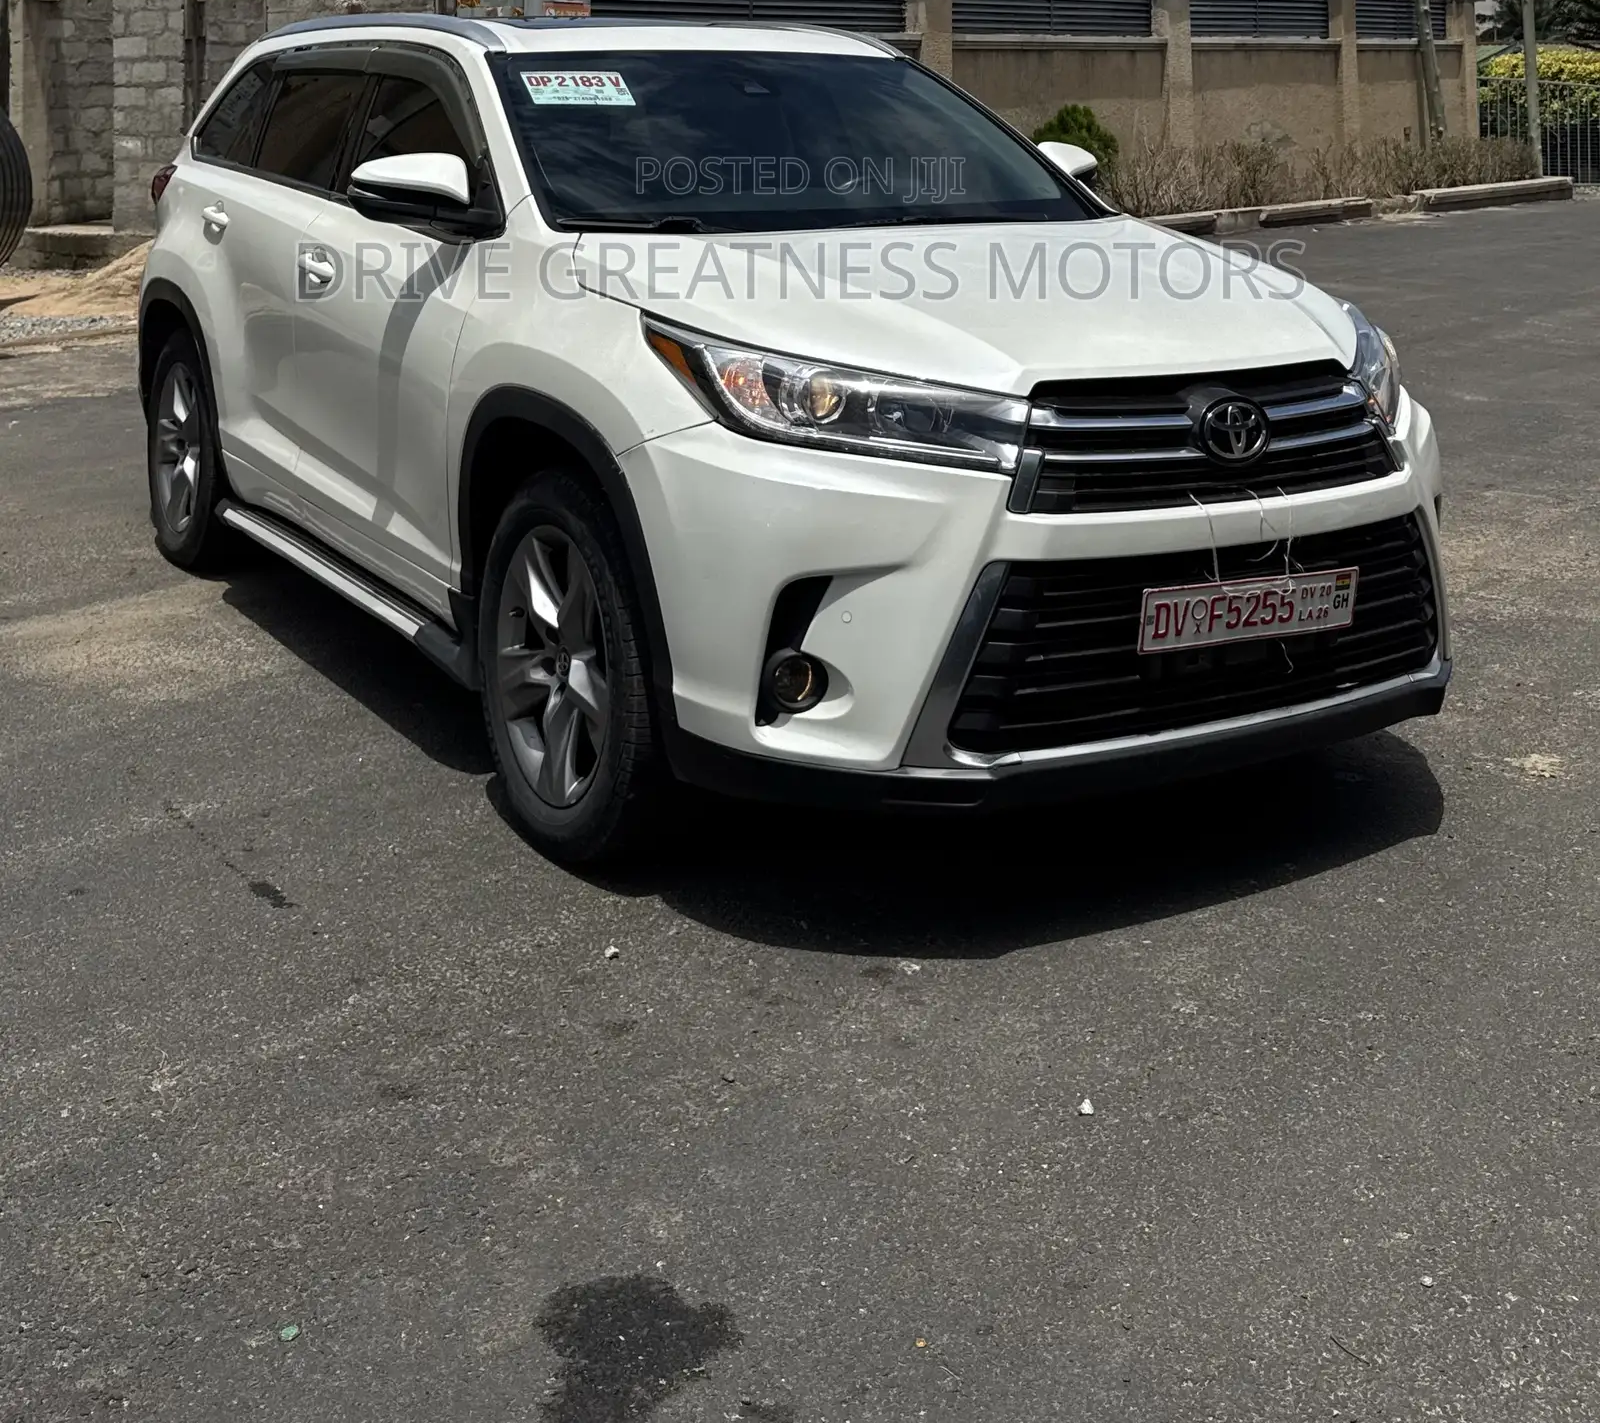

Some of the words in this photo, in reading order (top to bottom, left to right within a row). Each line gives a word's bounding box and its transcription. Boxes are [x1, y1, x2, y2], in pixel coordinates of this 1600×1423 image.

[1301, 584, 1316, 599] DV
[1333, 592, 1350, 610] GH
[1152, 599, 1191, 640] DV
[1208, 587, 1296, 633] F5255
[1298, 607, 1314, 621] LA
